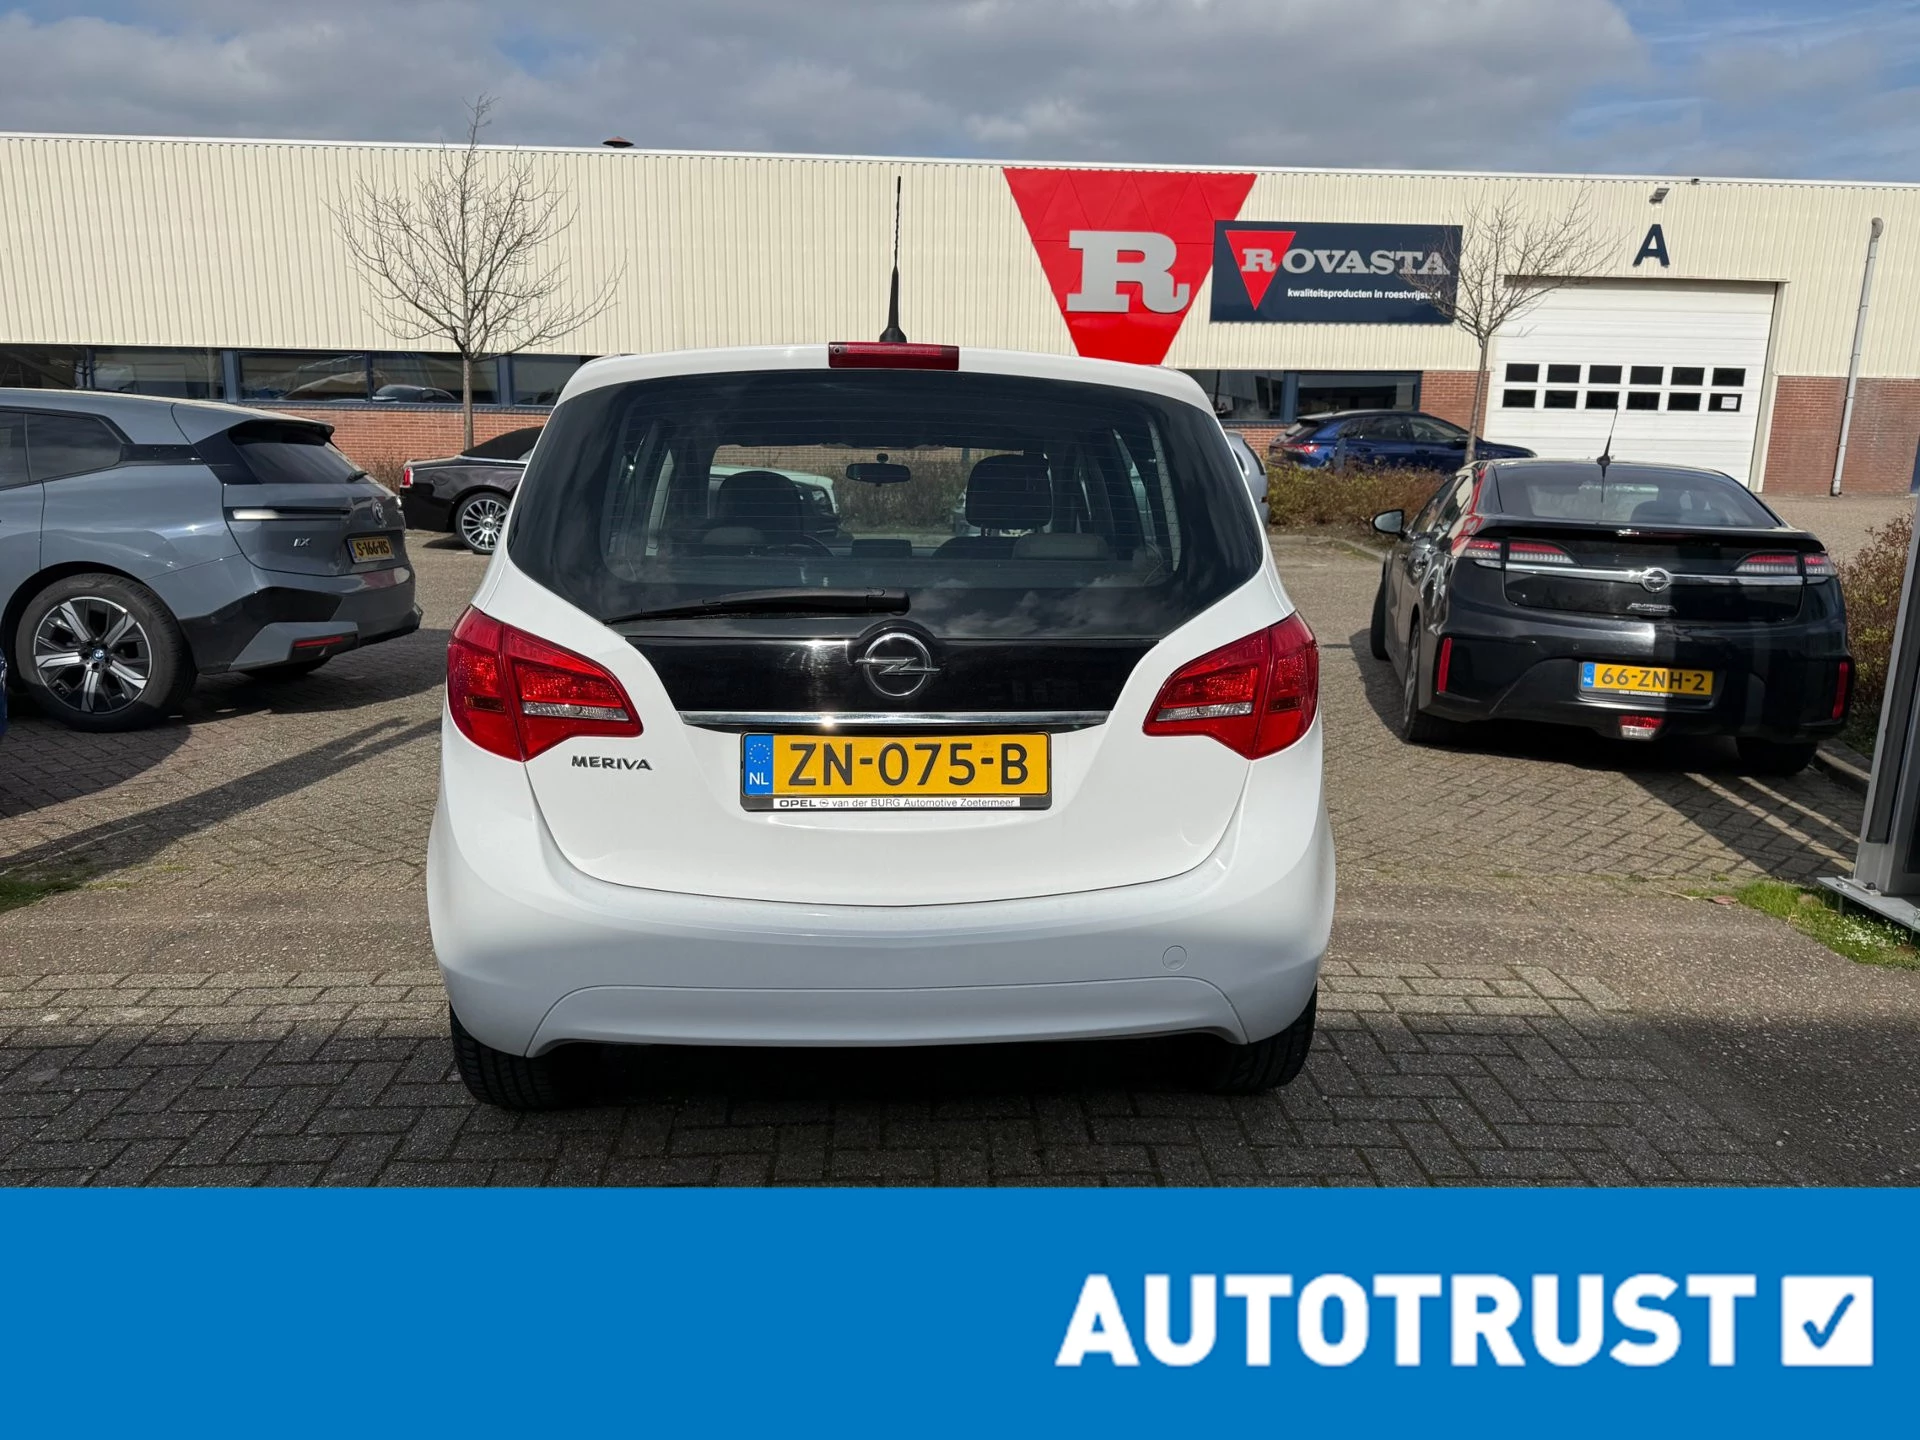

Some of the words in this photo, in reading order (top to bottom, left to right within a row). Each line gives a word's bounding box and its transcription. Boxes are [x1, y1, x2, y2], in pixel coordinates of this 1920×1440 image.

[1632, 223, 1671, 268] A
[1066, 230, 1190, 314] R
[1241, 248, 1451, 276] ROVASTA
[1287, 288, 1373, 300] kwaliteitsproducten
[1374, 289, 1383, 299] in
[1583, 676, 1593, 684] NL
[1601, 667, 1705, 691] 66-ZNH-2
[571, 755, 653, 771] MERIVA
[788, 742, 1028, 786] ZN-075-B
[749, 772, 769, 786] NL
[779, 799, 817, 808] OPEL
[832, 800, 849, 808] van
[852, 799, 868, 808] der
[870, 798, 901, 808] BURG
[903, 798, 958, 808] Automotive
[960, 798, 1015, 808] Zoetermeer
